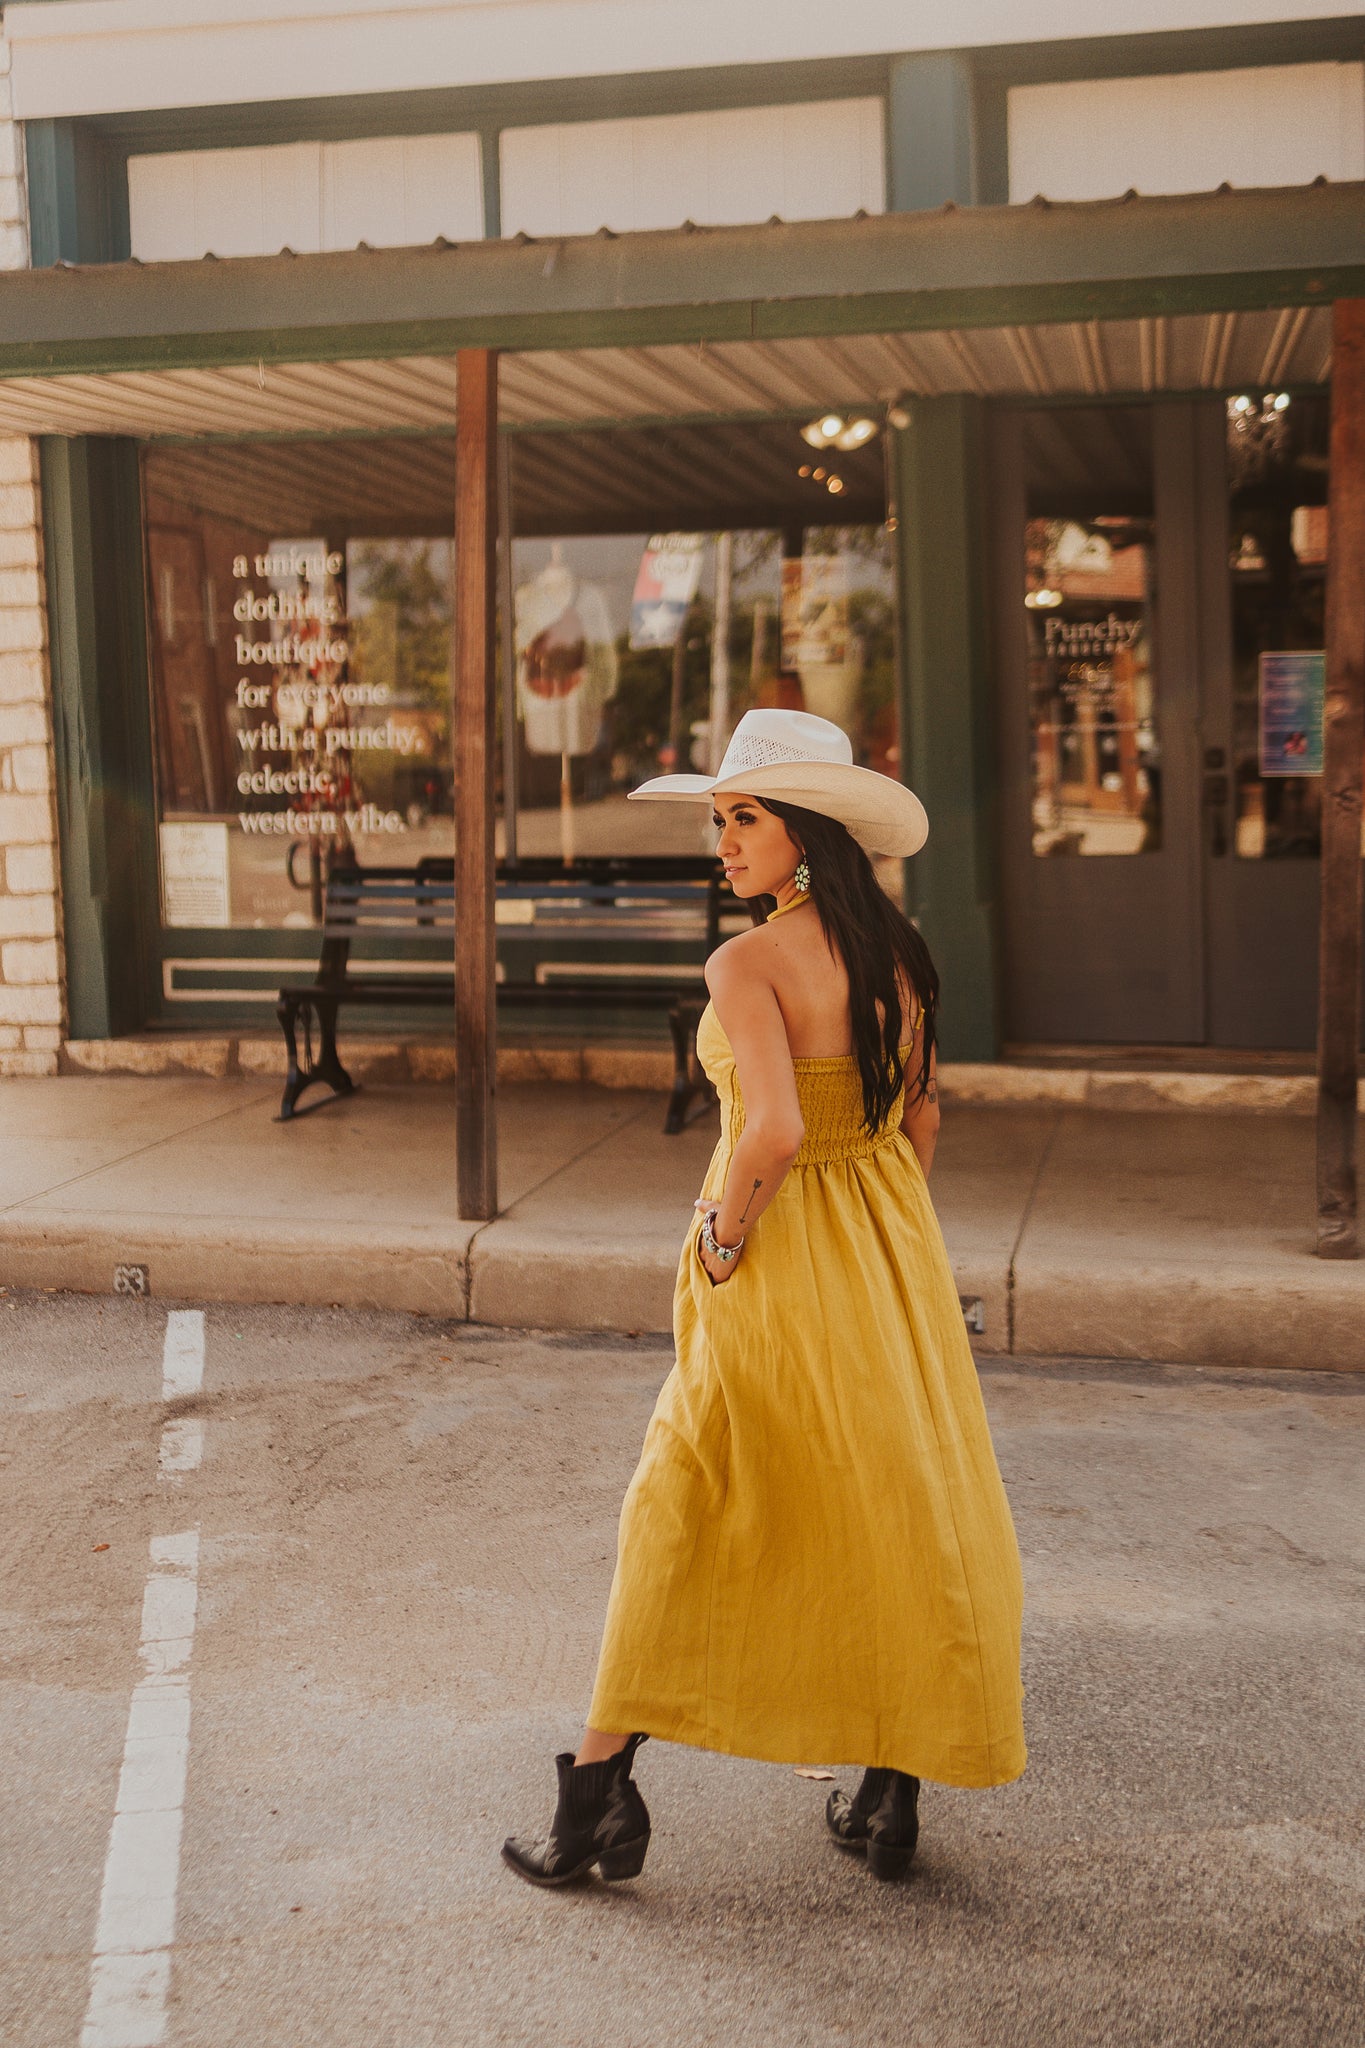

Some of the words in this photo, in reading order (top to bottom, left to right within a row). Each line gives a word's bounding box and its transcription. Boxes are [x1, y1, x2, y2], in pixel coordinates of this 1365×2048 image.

[233, 556, 247, 577] a
[254, 550, 343, 582] unique
[233, 591, 338, 623] clothing
[1044, 612, 1143, 647] Punchy
[235, 635, 349, 667] boutique
[236, 678, 271, 708] for
[277, 682, 389, 709] everyone
[237, 721, 296, 750] with
[303, 728, 316, 750] a
[239, 810, 337, 834] western
[343, 804, 404, 834] vibe.
